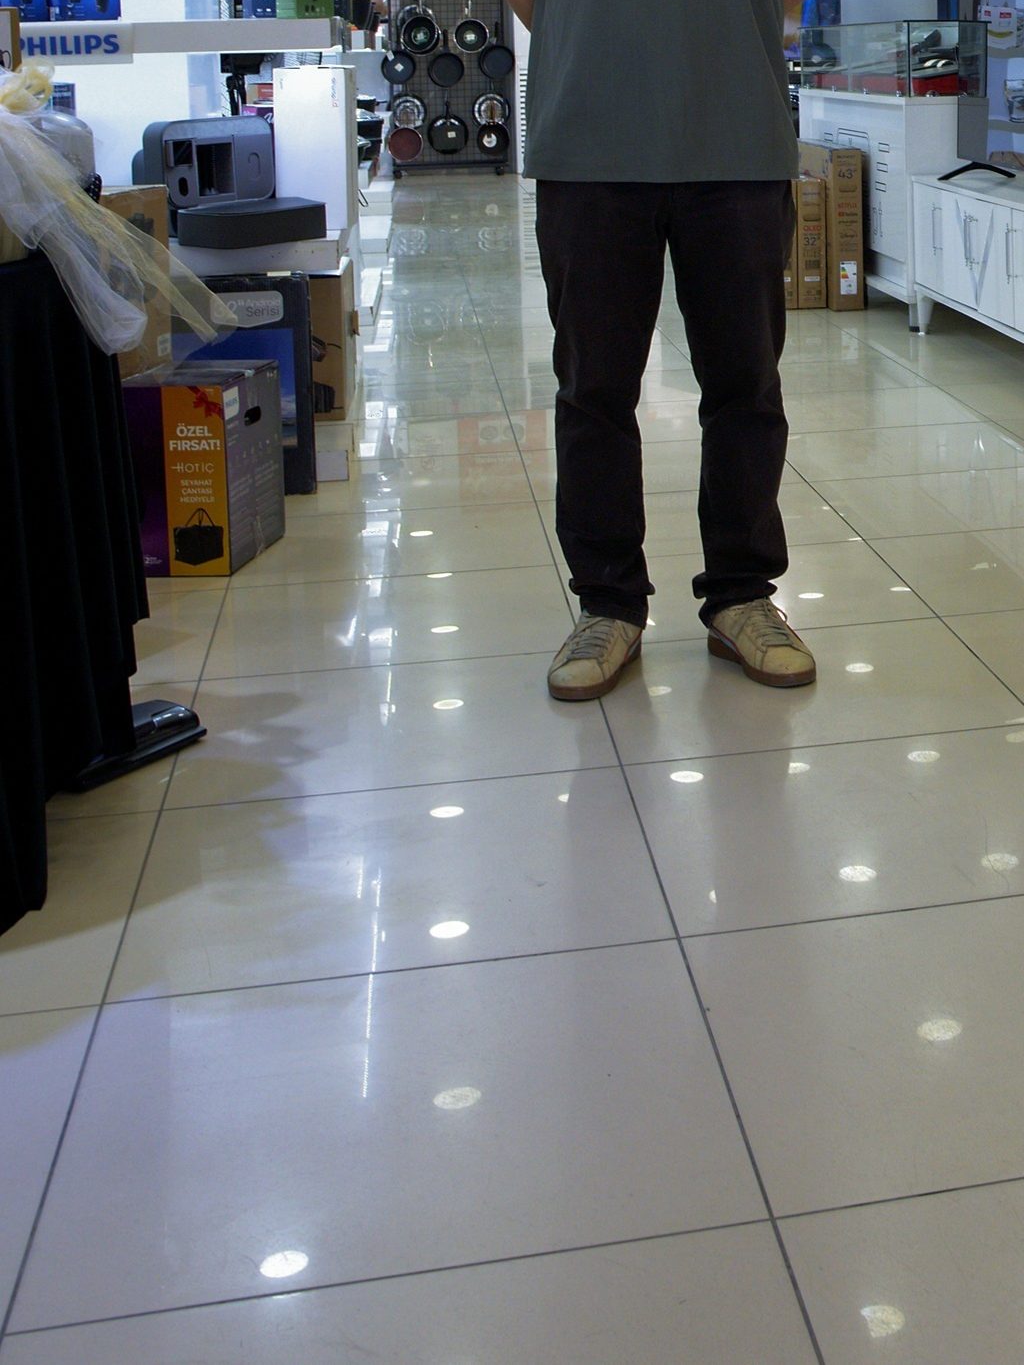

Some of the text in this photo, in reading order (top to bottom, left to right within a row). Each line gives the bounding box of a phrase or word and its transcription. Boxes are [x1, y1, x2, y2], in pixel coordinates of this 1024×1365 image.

[246, 306, 280, 317] Serisi
[176, 423, 213, 437] ÖZEL
[169, 439, 221, 452] FIRSAT!
